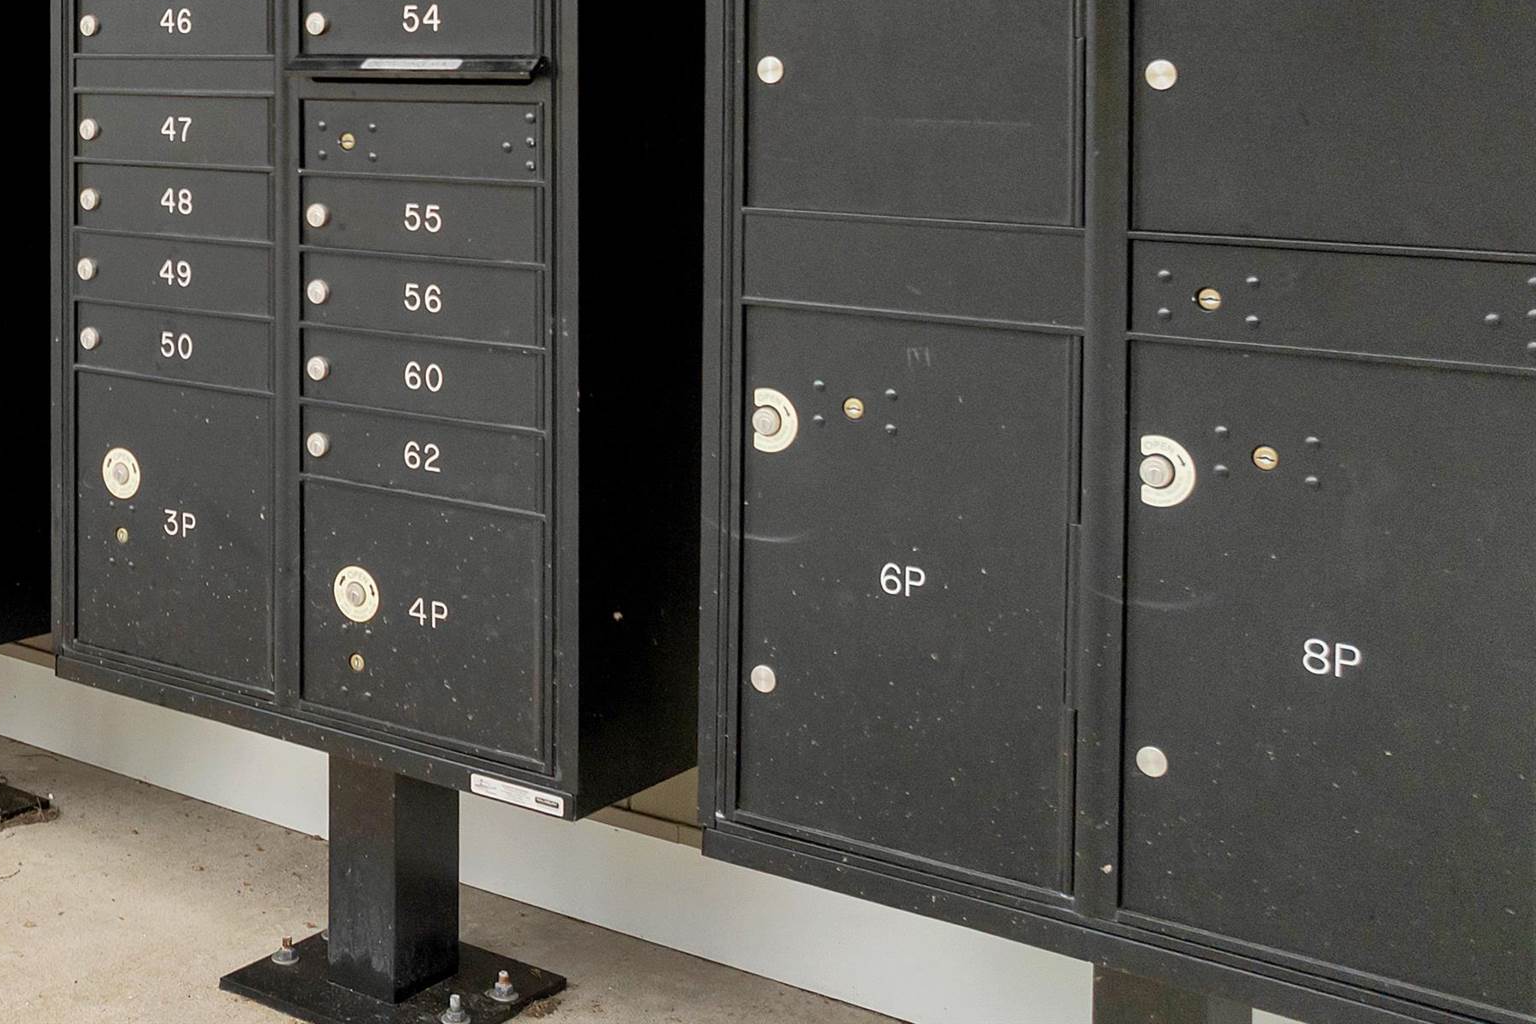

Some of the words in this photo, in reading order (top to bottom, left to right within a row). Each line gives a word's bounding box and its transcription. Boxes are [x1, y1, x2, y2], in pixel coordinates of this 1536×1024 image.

[159, 7, 193, 34] 46
[402, 3, 442, 33] 54
[160, 115, 193, 143] 47
[160, 187, 193, 215] 48
[403, 202, 442, 233] 55
[158, 258, 192, 288] 49
[403, 282, 442, 314] 56
[160, 330, 193, 360] 50
[404, 360, 444, 393] 60
[403, 440, 441, 473] 62
[1144, 440, 1175, 454] OPEN
[163, 508, 197, 539] 3P
[879, 562, 926, 598] 6P
[408, 597, 449, 629] 4P
[1302, 637, 1363, 678] 8P
